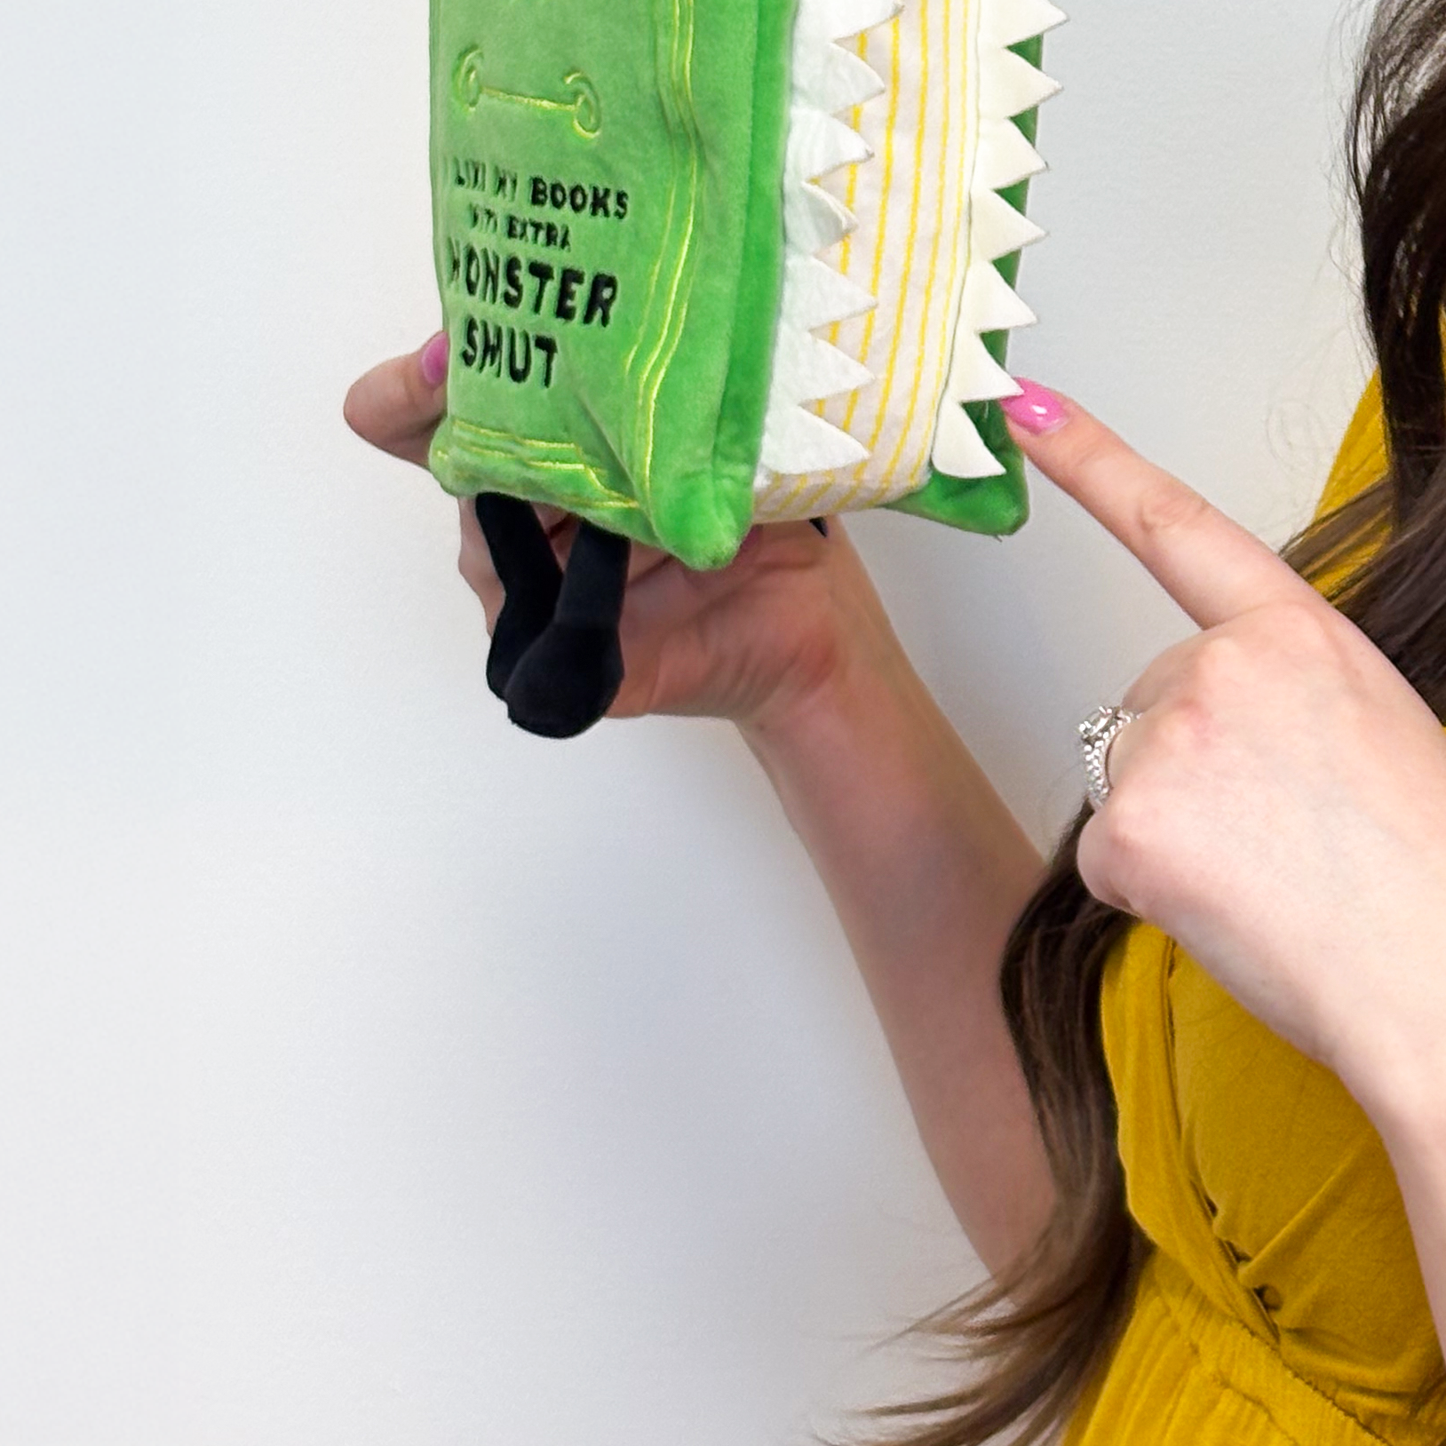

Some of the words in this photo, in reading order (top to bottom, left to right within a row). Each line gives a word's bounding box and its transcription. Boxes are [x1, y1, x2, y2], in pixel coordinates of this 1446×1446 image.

[530, 174, 629, 220] BOOKS
[506, 211, 571, 253] EXTRA
[447, 235, 618, 328] MONSTER
[461, 317, 558, 389] SMUT
